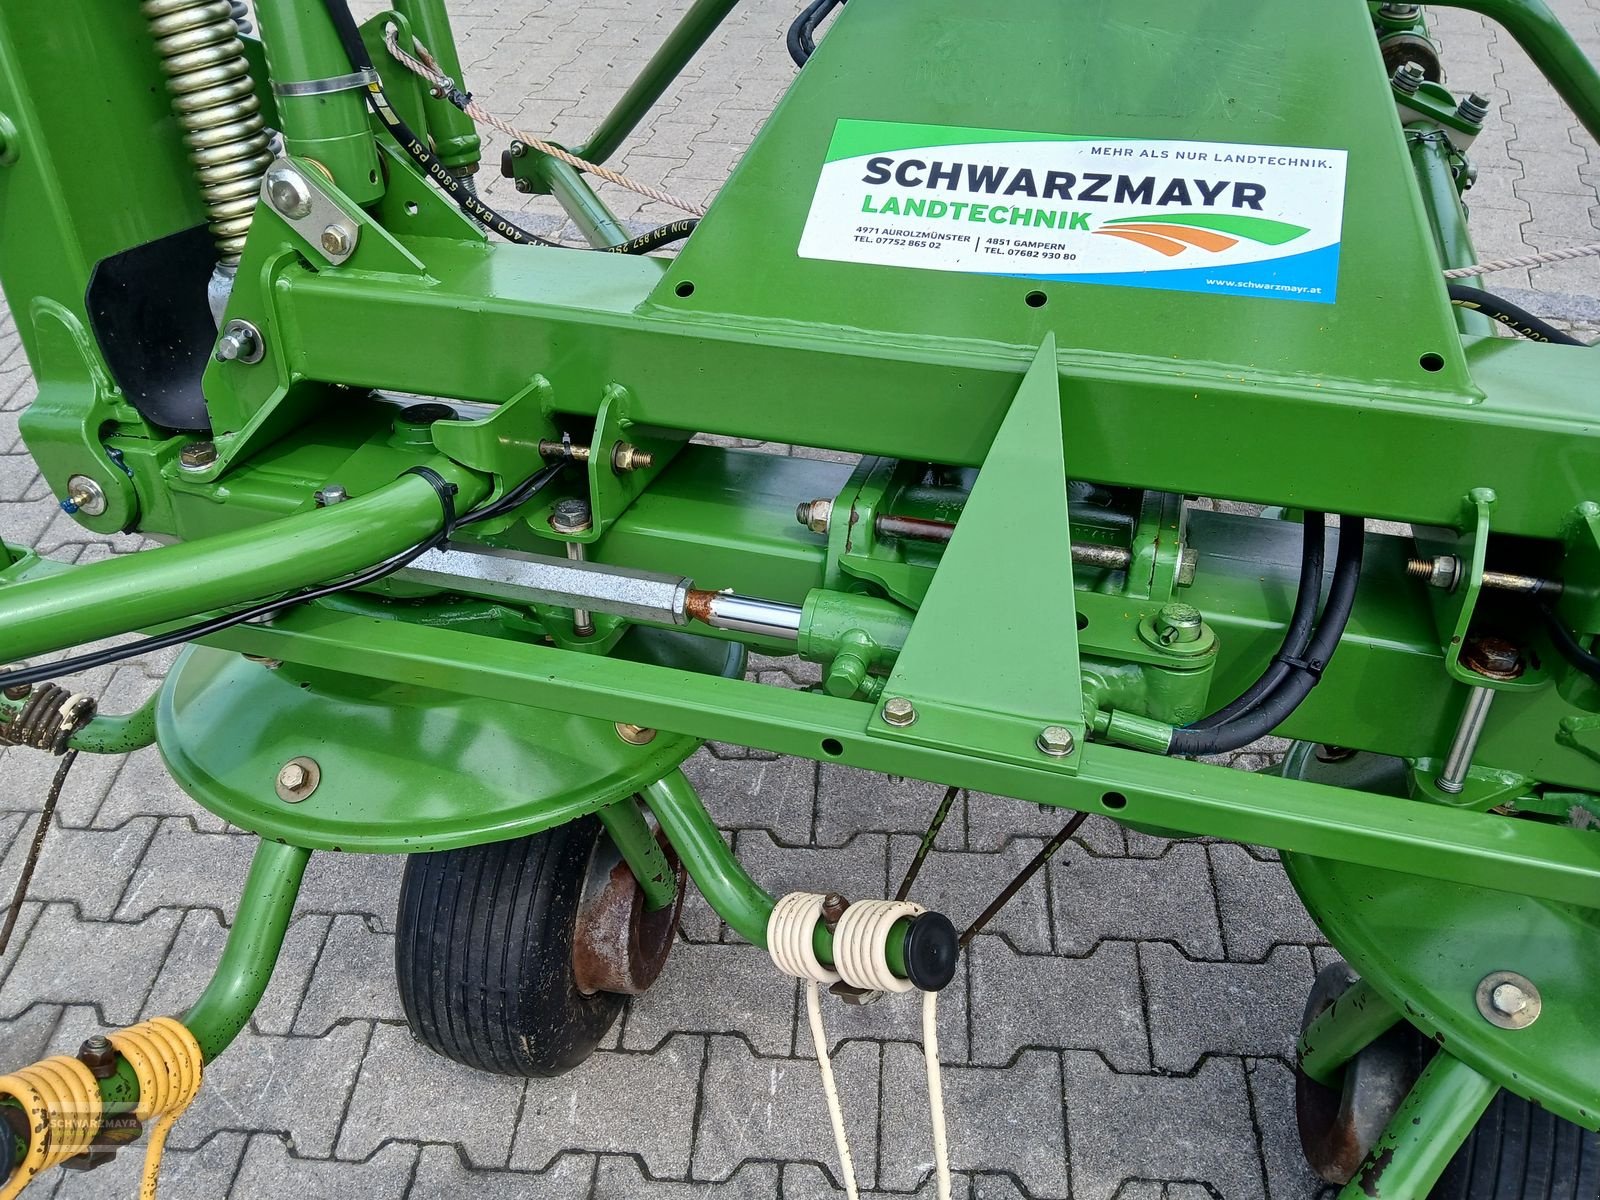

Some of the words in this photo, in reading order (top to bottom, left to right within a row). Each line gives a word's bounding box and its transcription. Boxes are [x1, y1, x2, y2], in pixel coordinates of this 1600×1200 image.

[408, 140, 430, 163] PSI
[1091, 146, 1133, 157] MEHR
[1139, 149, 1169, 159] ALS
[1176, 151, 1208, 162] NUR
[1214, 153, 1333, 169] LANDTECHNIK.
[431, 163, 459, 192] 5800
[862, 156, 1267, 211] SCHWARZMAYR
[466, 197, 494, 223] BAR
[861, 194, 1093, 231] LANDTECHNIK
[498, 221, 522, 241] 400
[654, 228, 667, 240] EN
[672, 221, 688, 233] DIN
[856, 226, 880, 235] 4971
[881, 228, 971, 243] AUROLZMÜNSTER
[633, 235, 650, 249] 857
[853, 235, 873, 244] TEL.
[875, 236, 906, 246] 07752
[908, 239, 927, 248] 865
[928, 240, 941, 249] 02
[986, 237, 1011, 246] 4851
[1013, 239, 1066, 251] GAMPERN
[984, 246, 1005, 255] TEL.
[1007, 248, 1039, 258] 07682
[1042, 251, 1061, 260] 930
[1063, 252, 1077, 261] 80
[1206, 278, 1322, 294] www.schwarzmayr.at
